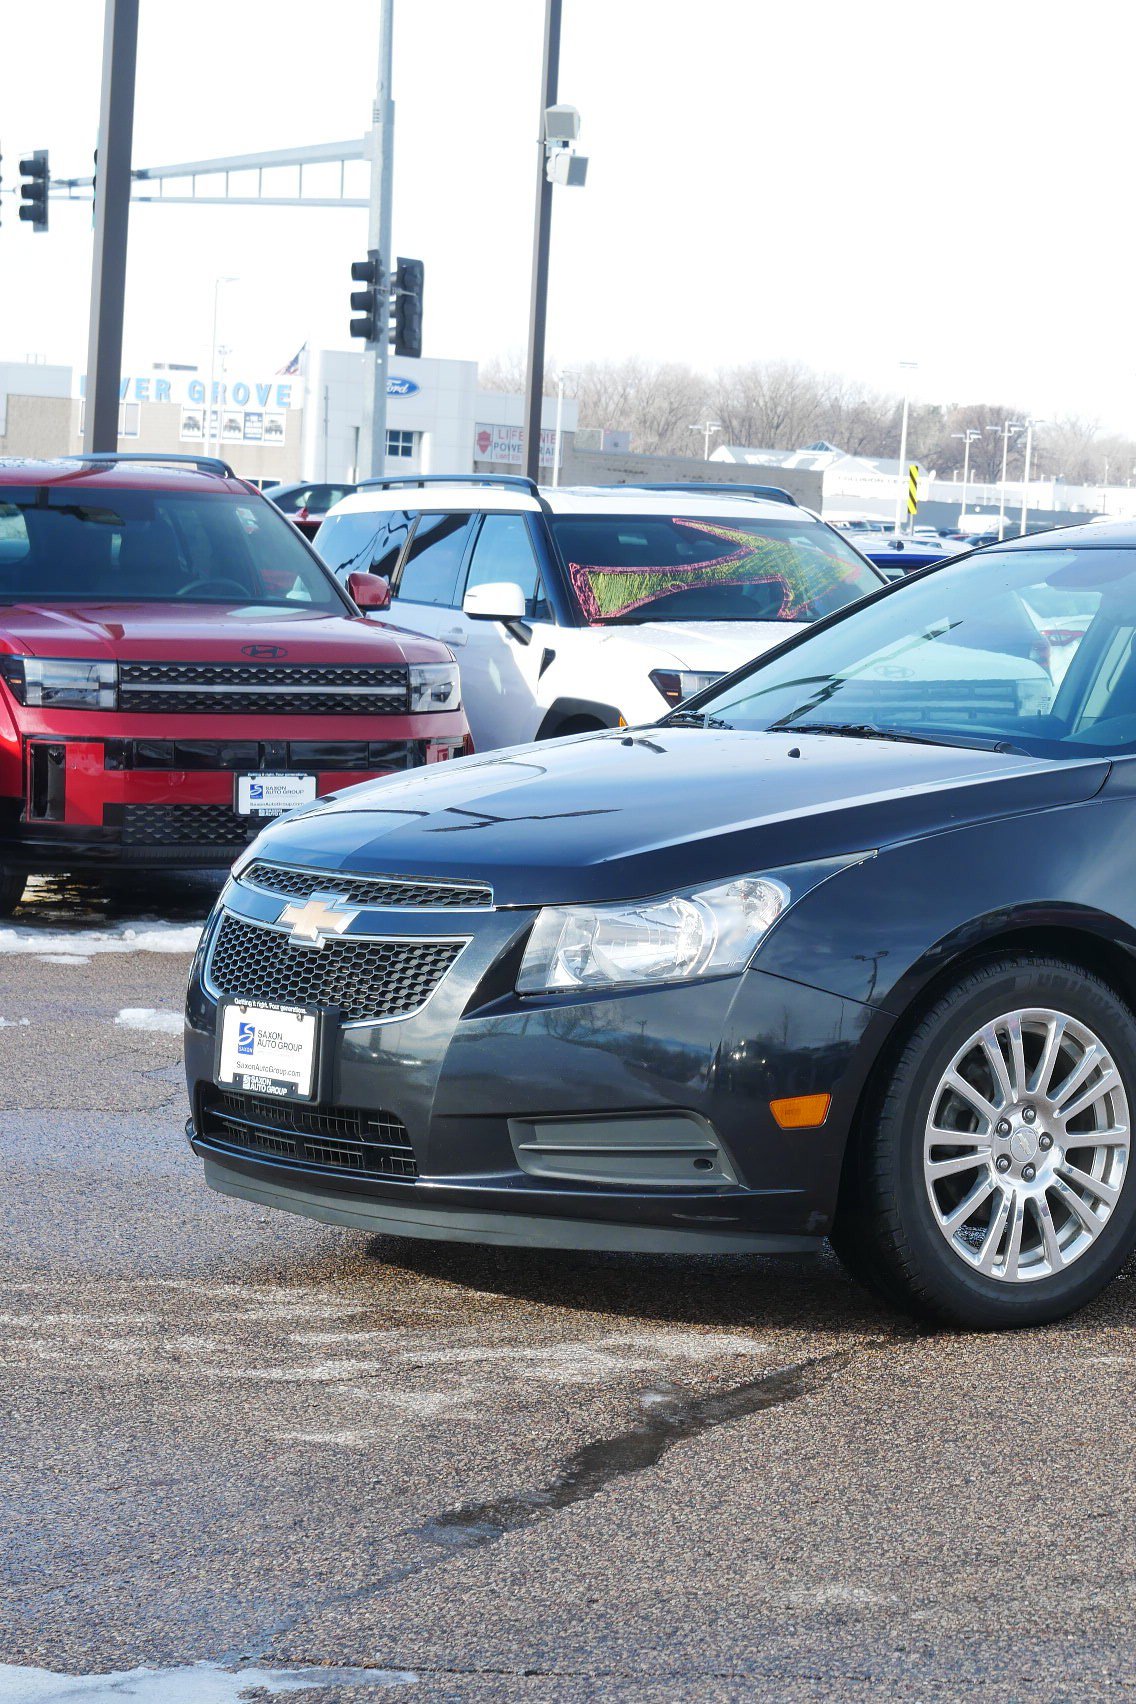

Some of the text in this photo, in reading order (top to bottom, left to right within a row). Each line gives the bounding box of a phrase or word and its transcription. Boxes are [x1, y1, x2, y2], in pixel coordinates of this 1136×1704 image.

[80, 374, 292, 407] IVER GROVE
[257, 1029, 283, 1040] SAXON
[257, 1039, 303, 1053] AUTO GROUP
[236, 1061, 301, 1078] SaxonAutoGroup.com
[250, 1076, 272, 1086] SAXON
[249, 1084, 288, 1096] AUTO GROUP
